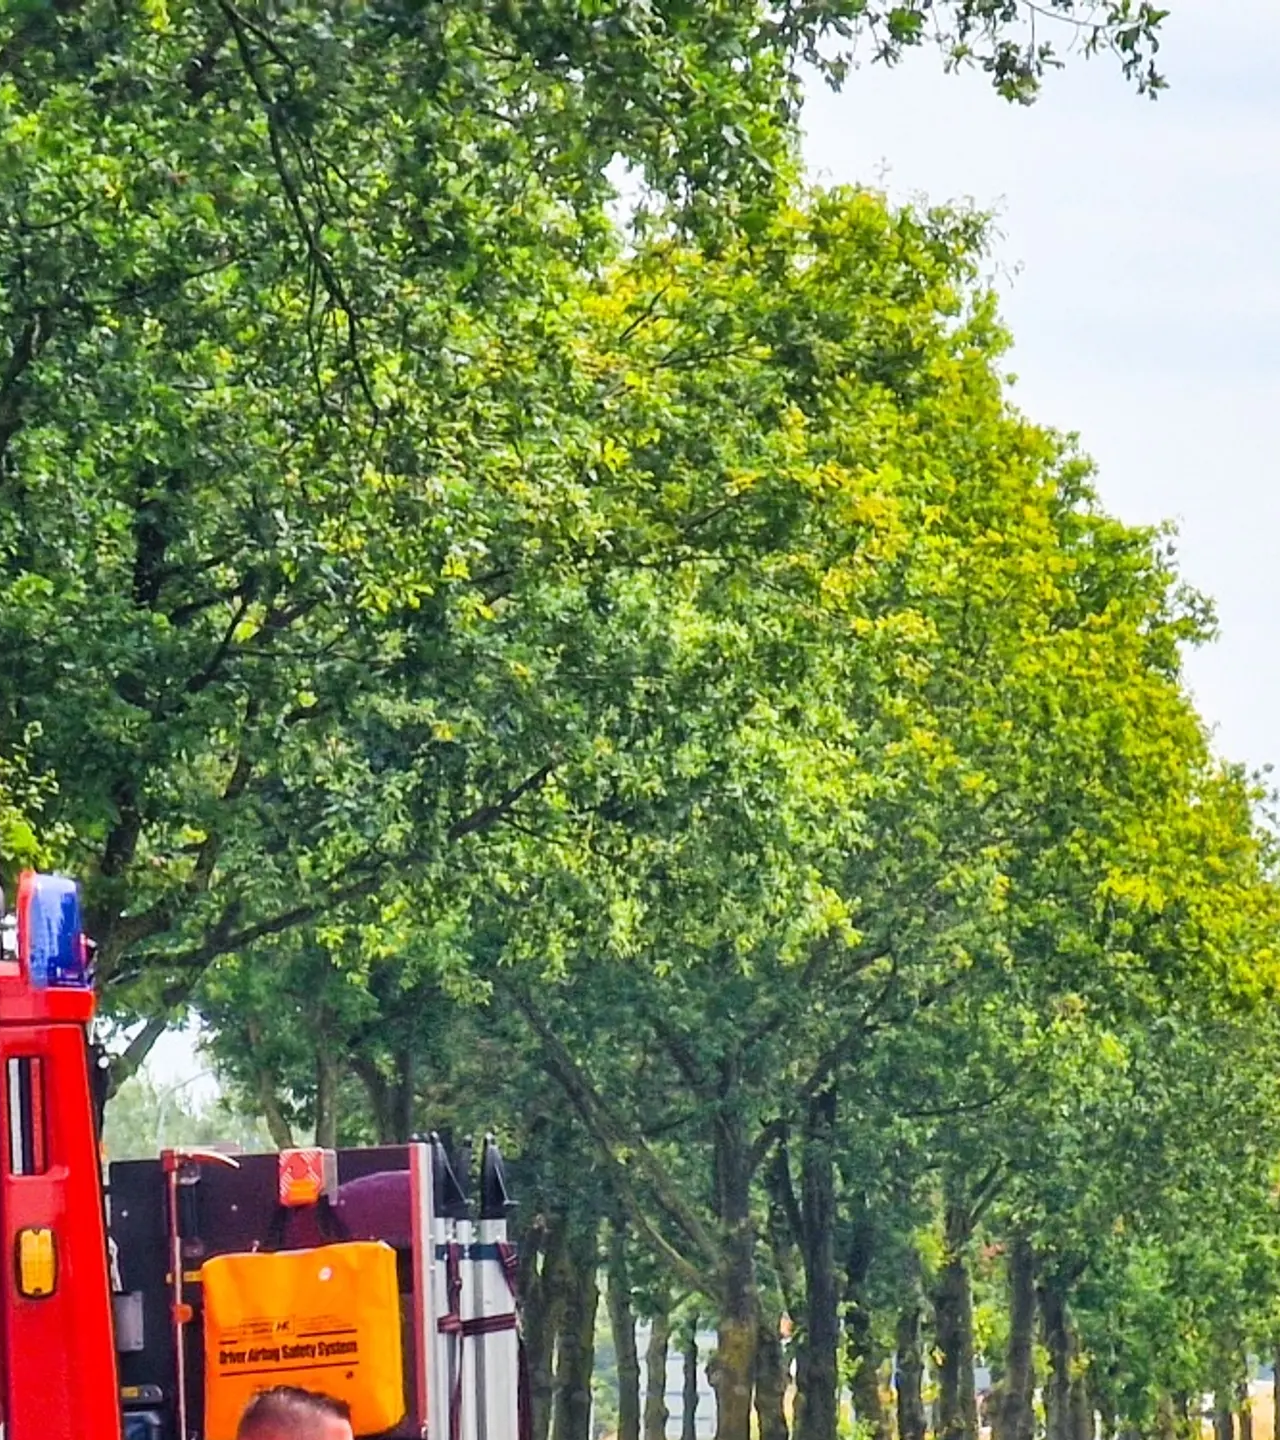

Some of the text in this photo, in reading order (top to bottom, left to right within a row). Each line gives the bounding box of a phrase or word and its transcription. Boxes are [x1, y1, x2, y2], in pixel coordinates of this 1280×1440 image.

[219, 1350, 246, 1365] Driver
[247, 1347, 280, 1363] Airbag
[281, 1344, 316, 1360] Safety
